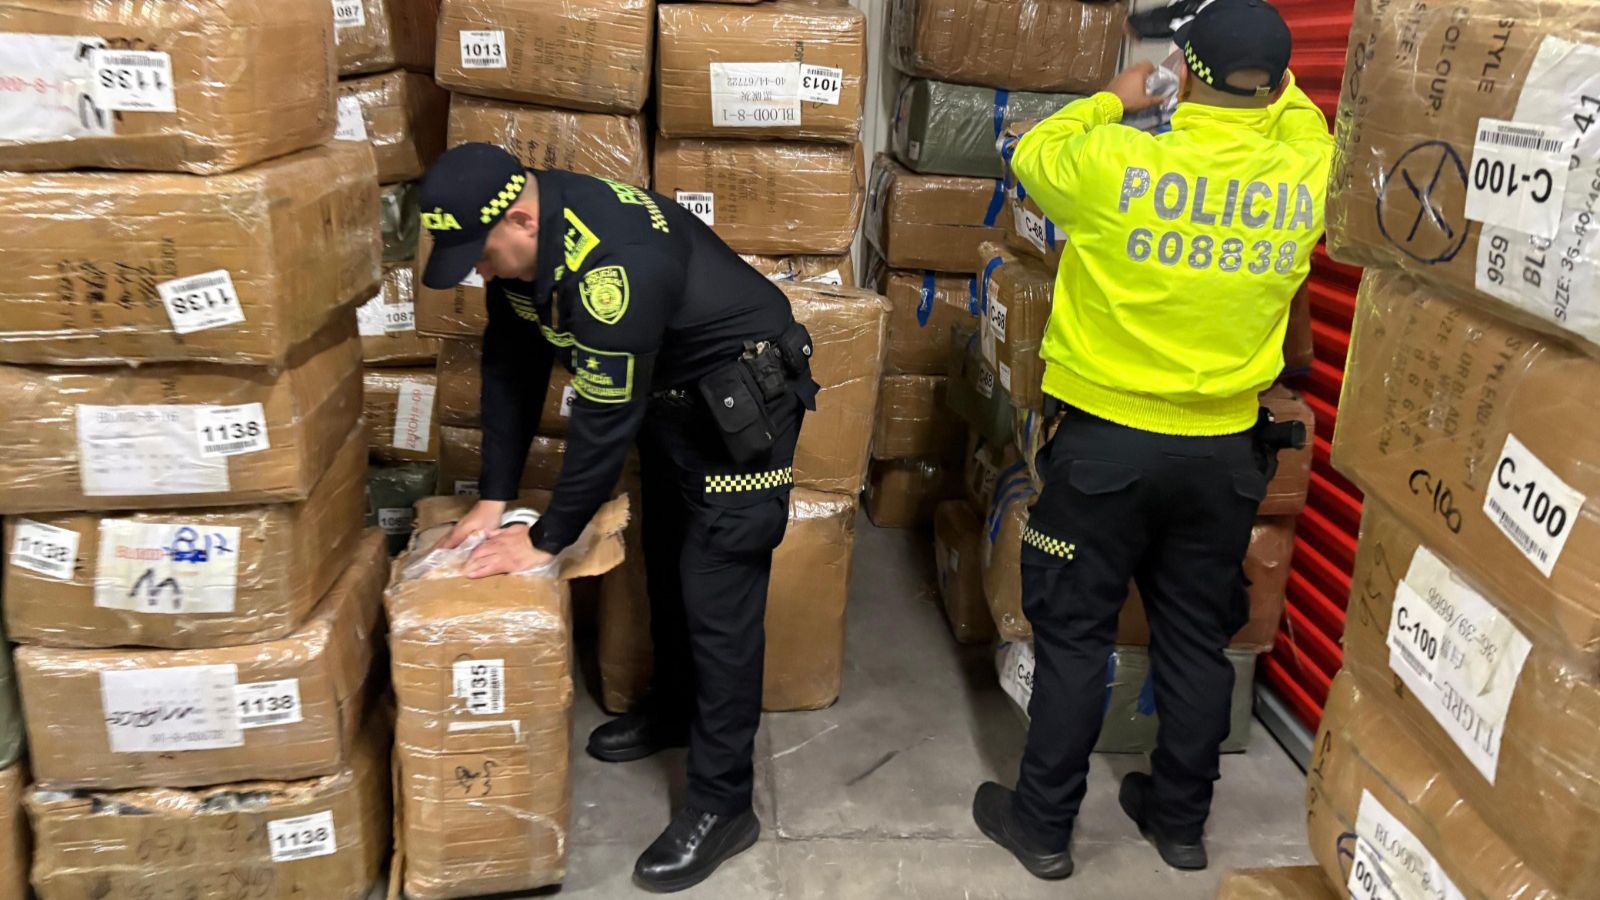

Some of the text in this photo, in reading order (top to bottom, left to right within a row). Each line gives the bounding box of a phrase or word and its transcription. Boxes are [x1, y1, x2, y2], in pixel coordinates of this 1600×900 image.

[463, 43, 501, 56] 1013
[1478, 18, 1515, 93] STYLE
[99, 68, 167, 90] 1138
[803, 75, 838, 91] 1013
[723, 108, 795, 122] BLOOD-8-1
[1118, 166, 1313, 231] POLICIA
[1474, 158, 1552, 203] C-100
[1126, 228, 1297, 275] 608838
[1486, 235, 1509, 286] 959
[171, 285, 233, 316] 1138
[386, 312, 415, 323] 1087
[1555, 278, 1571, 322] SIZE:
[201, 420, 262, 443] 1138
[1409, 469, 1462, 534] C-100
[1497, 457, 1567, 538] C-100
[17, 537, 70, 562] 1138
[1397, 607, 1438, 661] C-100
[238, 695, 295, 713] 1138
[470, 664, 488, 711] 1135
[276, 827, 331, 849] 1138
